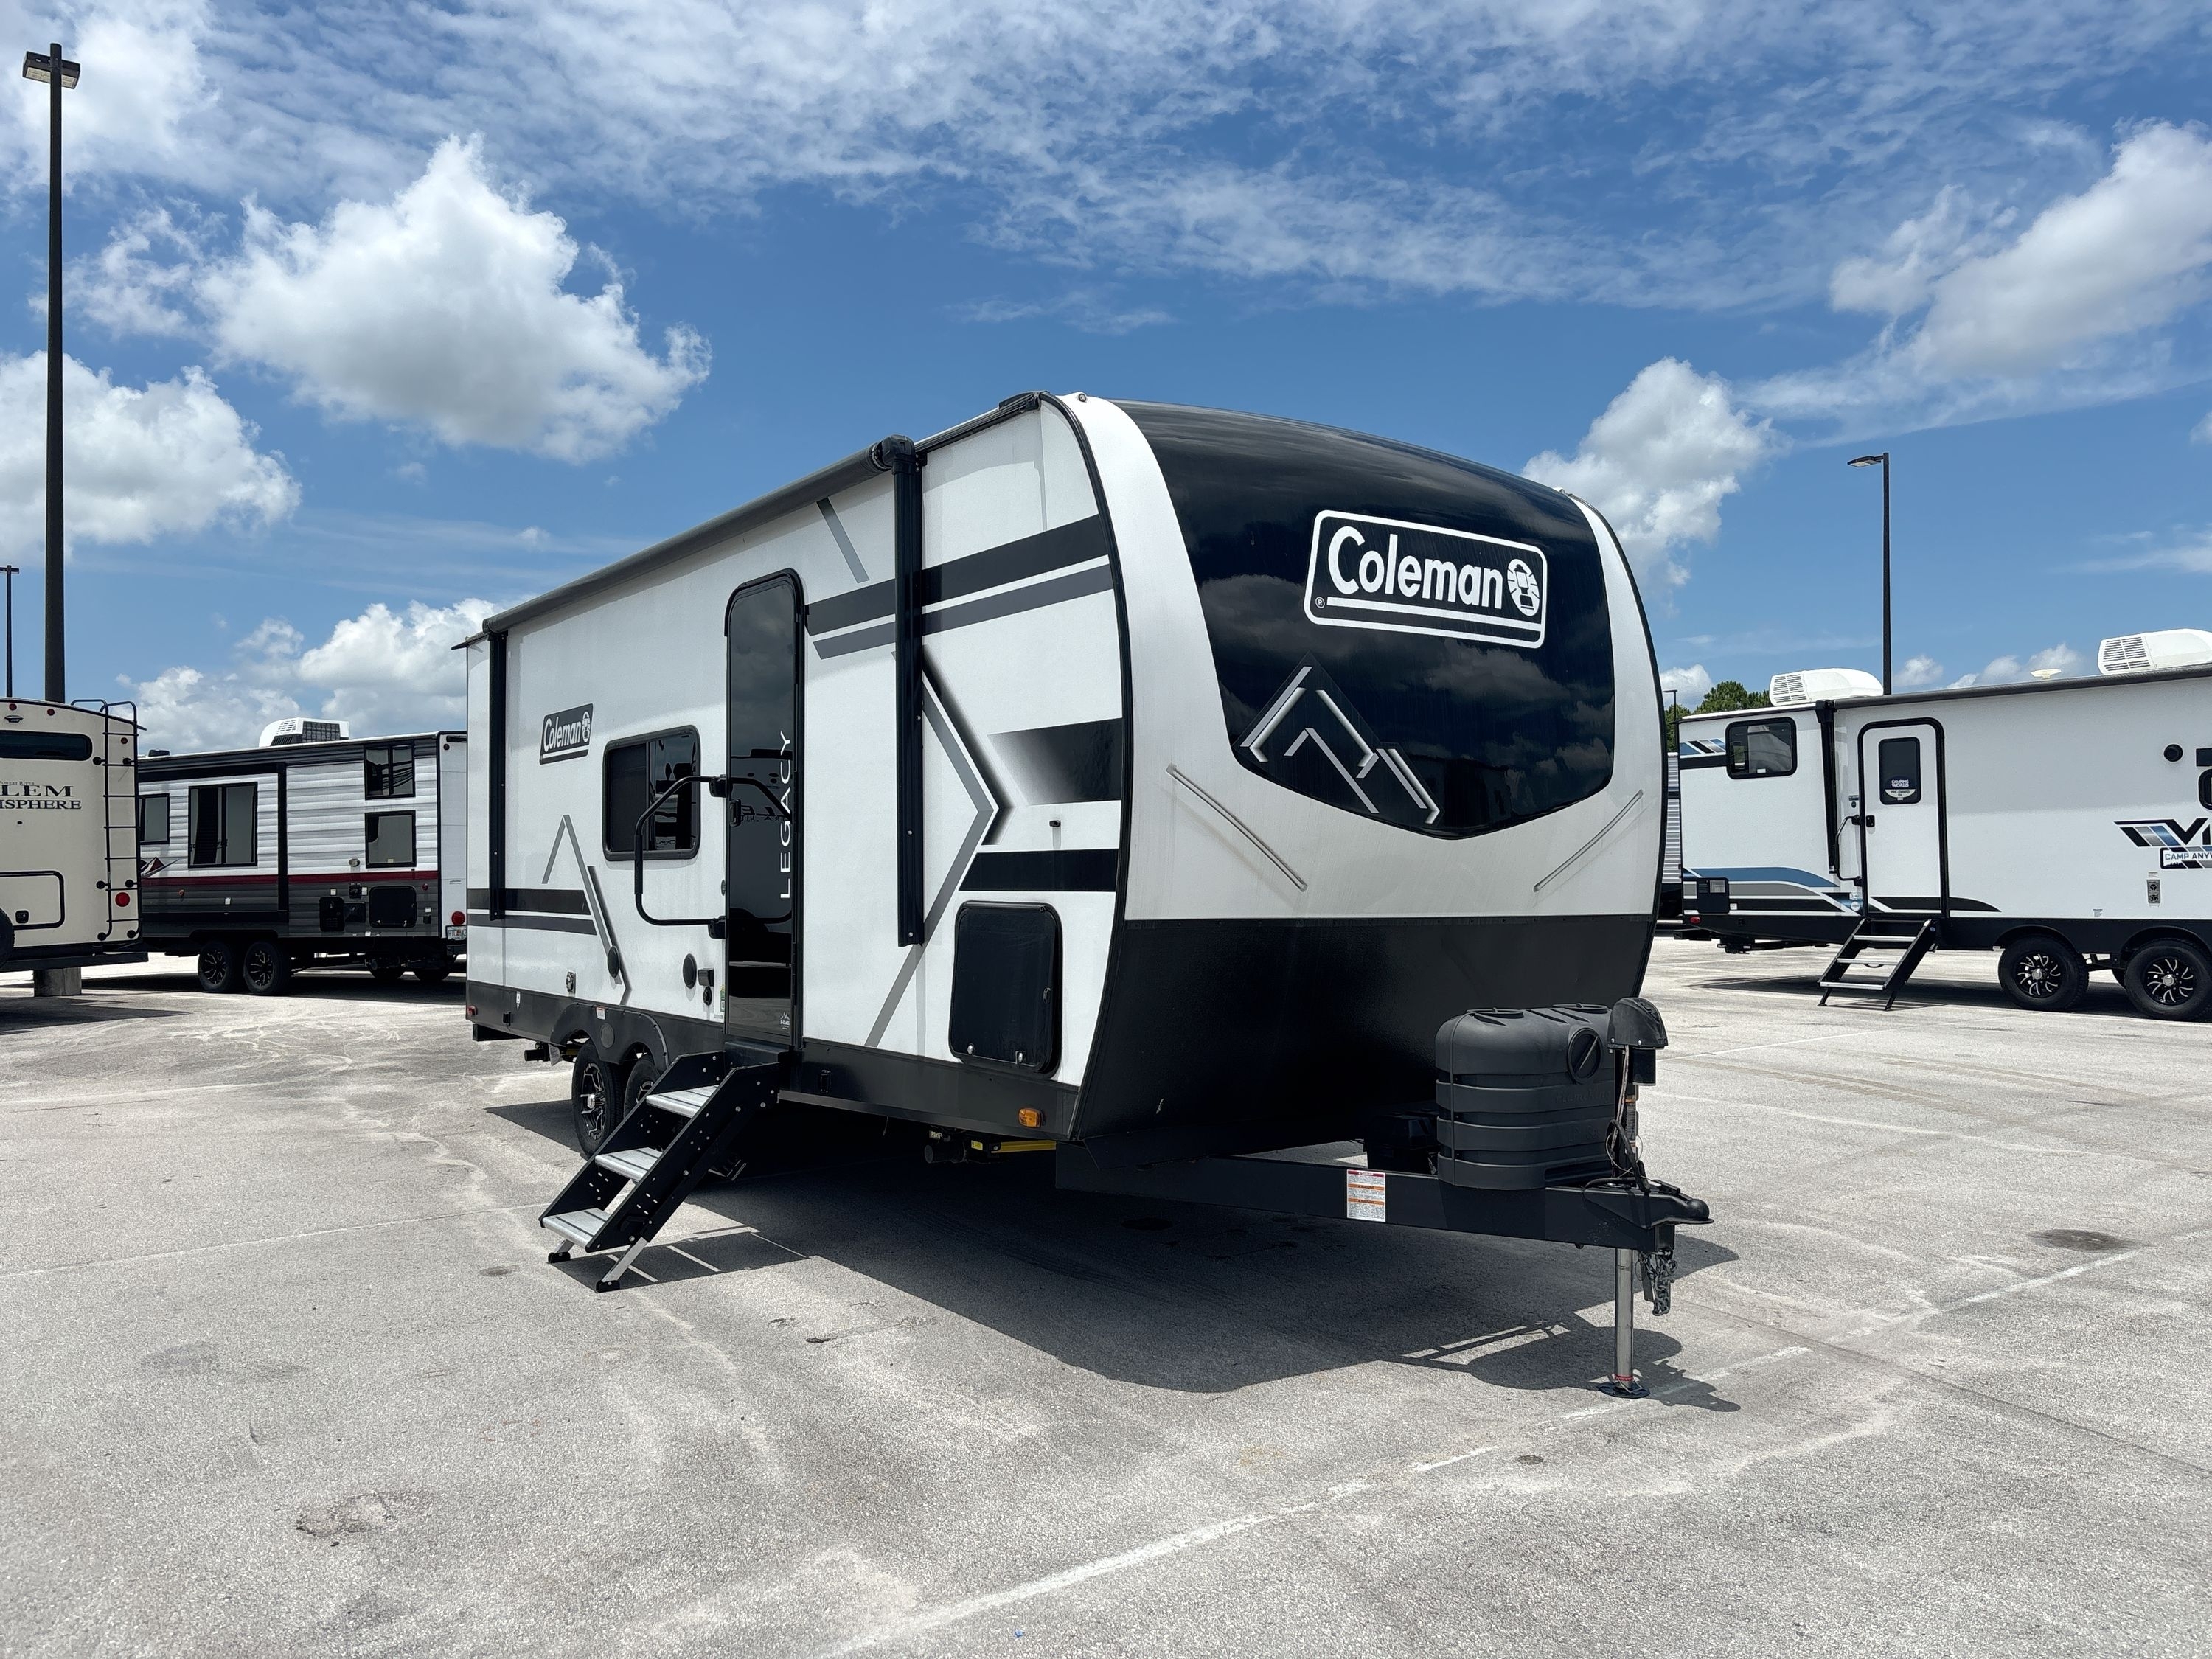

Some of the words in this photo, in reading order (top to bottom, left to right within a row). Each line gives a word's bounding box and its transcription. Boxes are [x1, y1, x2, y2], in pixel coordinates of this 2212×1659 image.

[1328, 526, 1503, 610] Coleman
[543, 716, 582, 752] Coleman
[780, 730, 790, 899] LEGACY
